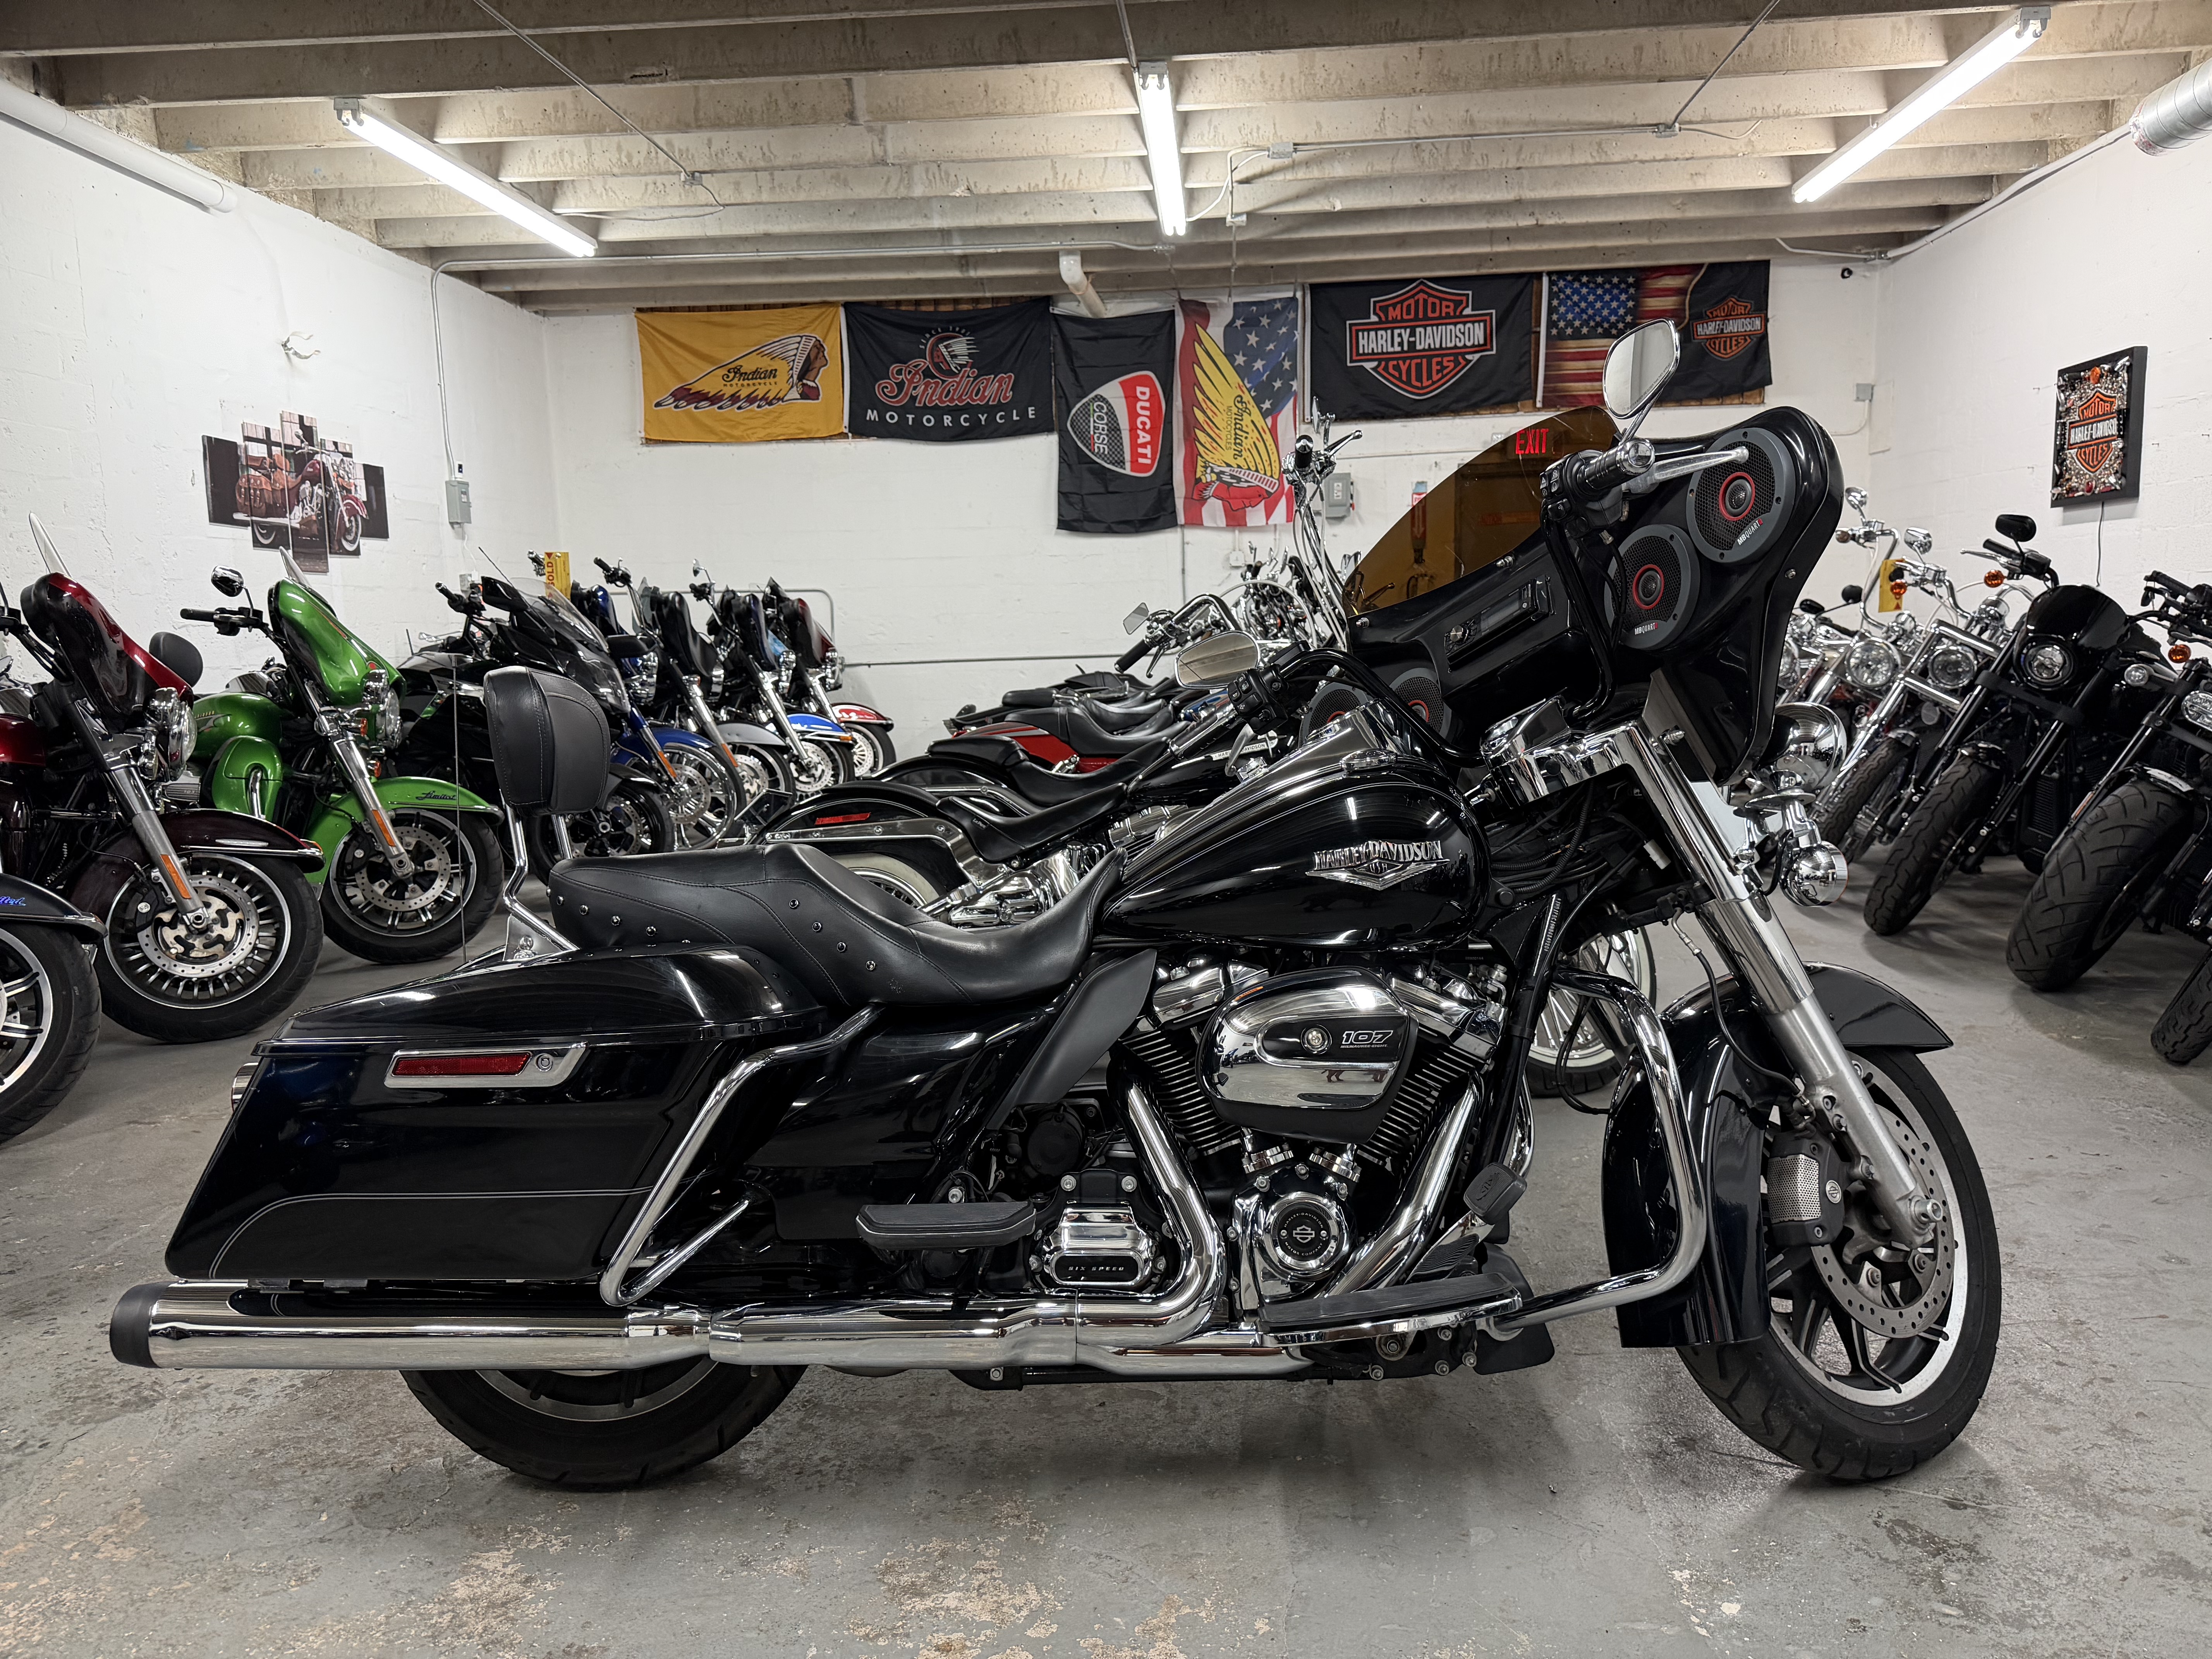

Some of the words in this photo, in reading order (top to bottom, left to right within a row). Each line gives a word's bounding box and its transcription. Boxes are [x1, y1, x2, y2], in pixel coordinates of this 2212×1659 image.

[1388, 292, 1455, 321] MOTOR
[1713, 302, 1745, 317] MOTOR
[919, 328, 941, 349] SINCE
[1358, 322, 1484, 354] HARLEY-DAVIDSON
[1711, 337, 1745, 354] CYCLES
[722, 365, 778, 383] Indian
[875, 359, 1014, 407] Indian
[1388, 356, 1455, 387] CYCLES
[866, 407, 1036, 427] MOTORCYCLE
[2084, 398, 2111, 419] MOTOR
[1094, 402, 1108, 454] CORSE
[1136, 386, 1152, 464] DUCATI
[1233, 394, 1251, 460] Indian
[1516, 428, 1549, 454] EXIT
[2081, 443, 2108, 466] CYCLES
[546, 562, 555, 589] SOLD
[1313, 840, 1443, 870] HARLEY-DAVIDSON
[1342, 1030, 1393, 1044] 107
[1285, 1242, 1299, 1255] MOTOR
[1302, 1243, 1322, 1256] COMPANY
